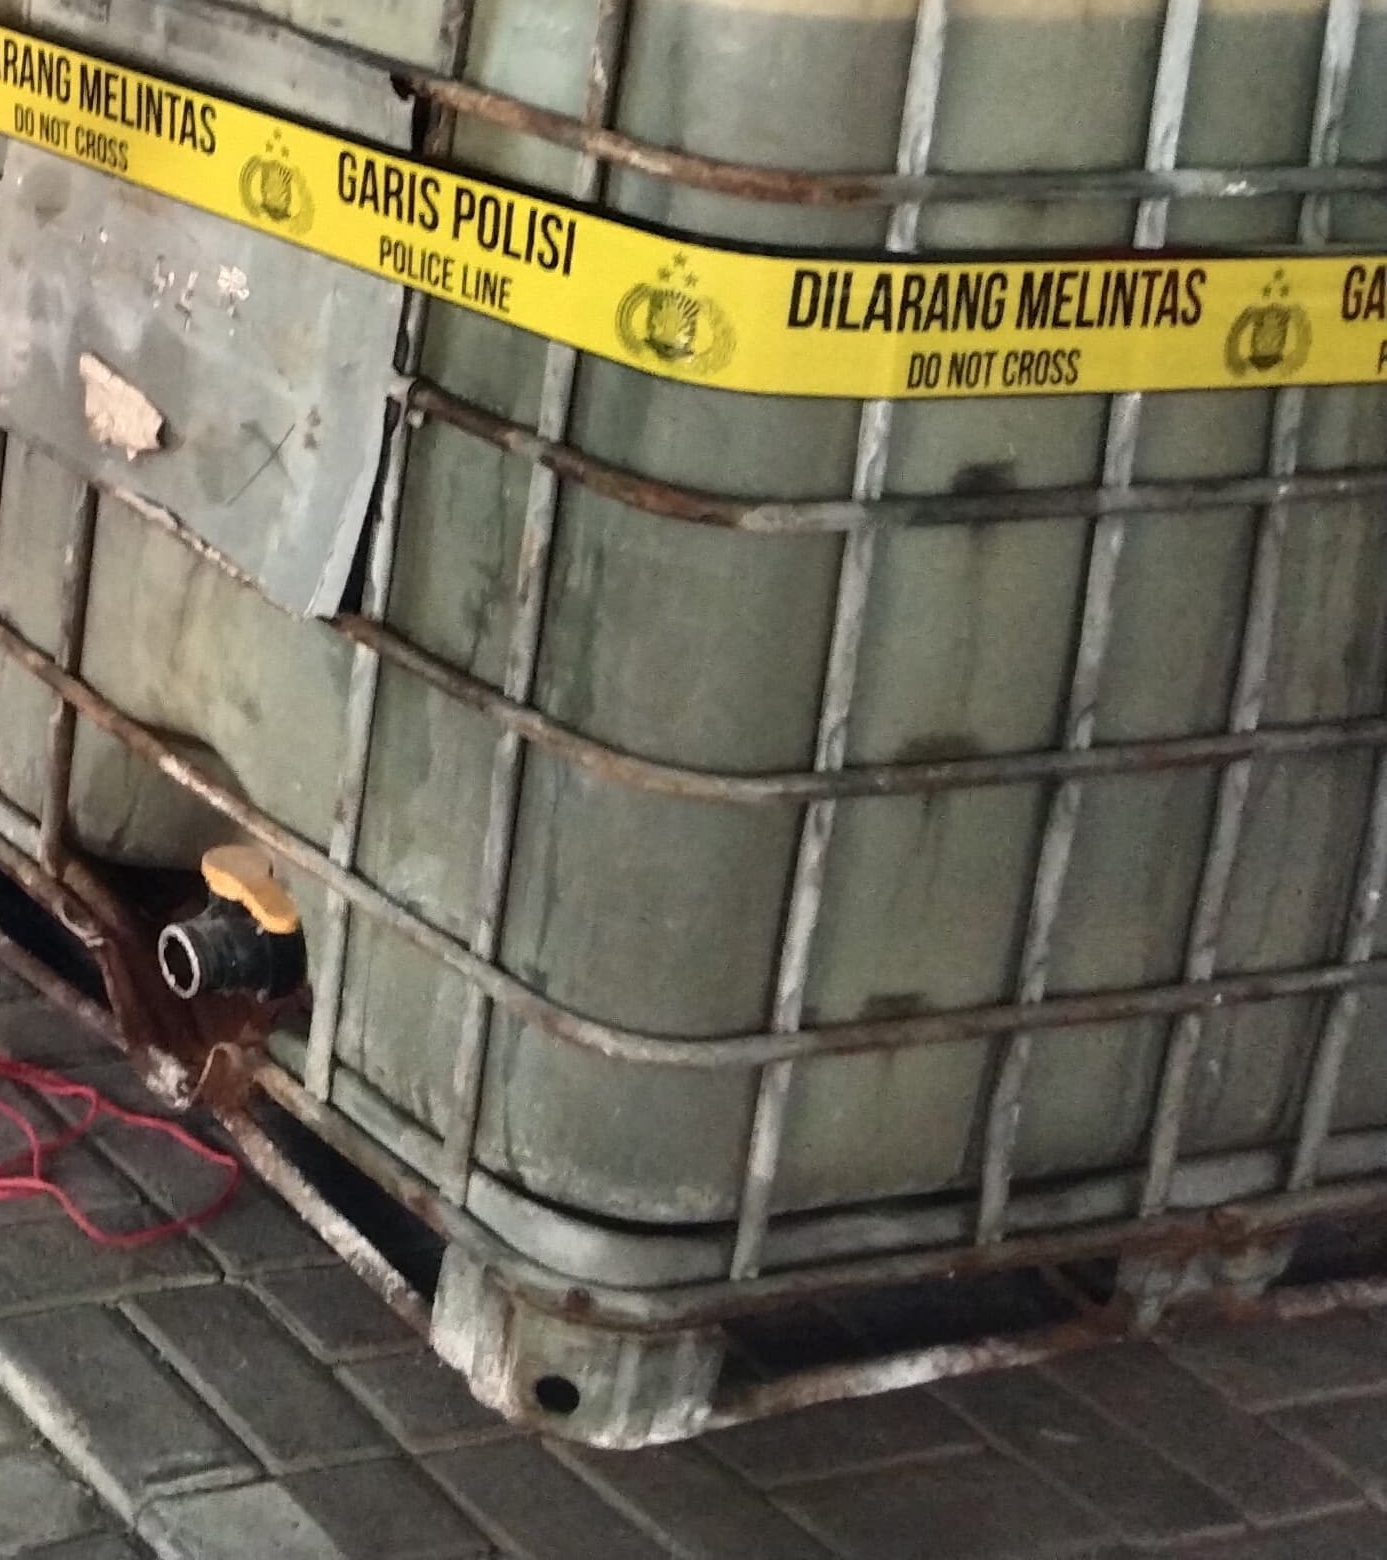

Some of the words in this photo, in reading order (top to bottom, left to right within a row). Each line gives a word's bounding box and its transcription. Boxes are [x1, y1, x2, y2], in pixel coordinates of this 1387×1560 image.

[14, 102, 34, 136] DO
[39, 111, 71, 149] NOT
[75, 124, 130, 172] CROSS
[78, 61, 218, 157] MELINTAS
[337, 150, 441, 233] GARIS
[452, 184, 577, 278] POLISI
[379, 234, 455, 293] POLICE
[461, 262, 513, 313] LINE
[786, 268, 1008, 333] DILARANG
[1014, 268, 1208, 329] MELINTAS
[906, 350, 941, 391] DO
[946, 350, 999, 388] NOT
[1001, 347, 1083, 387] CROSS
